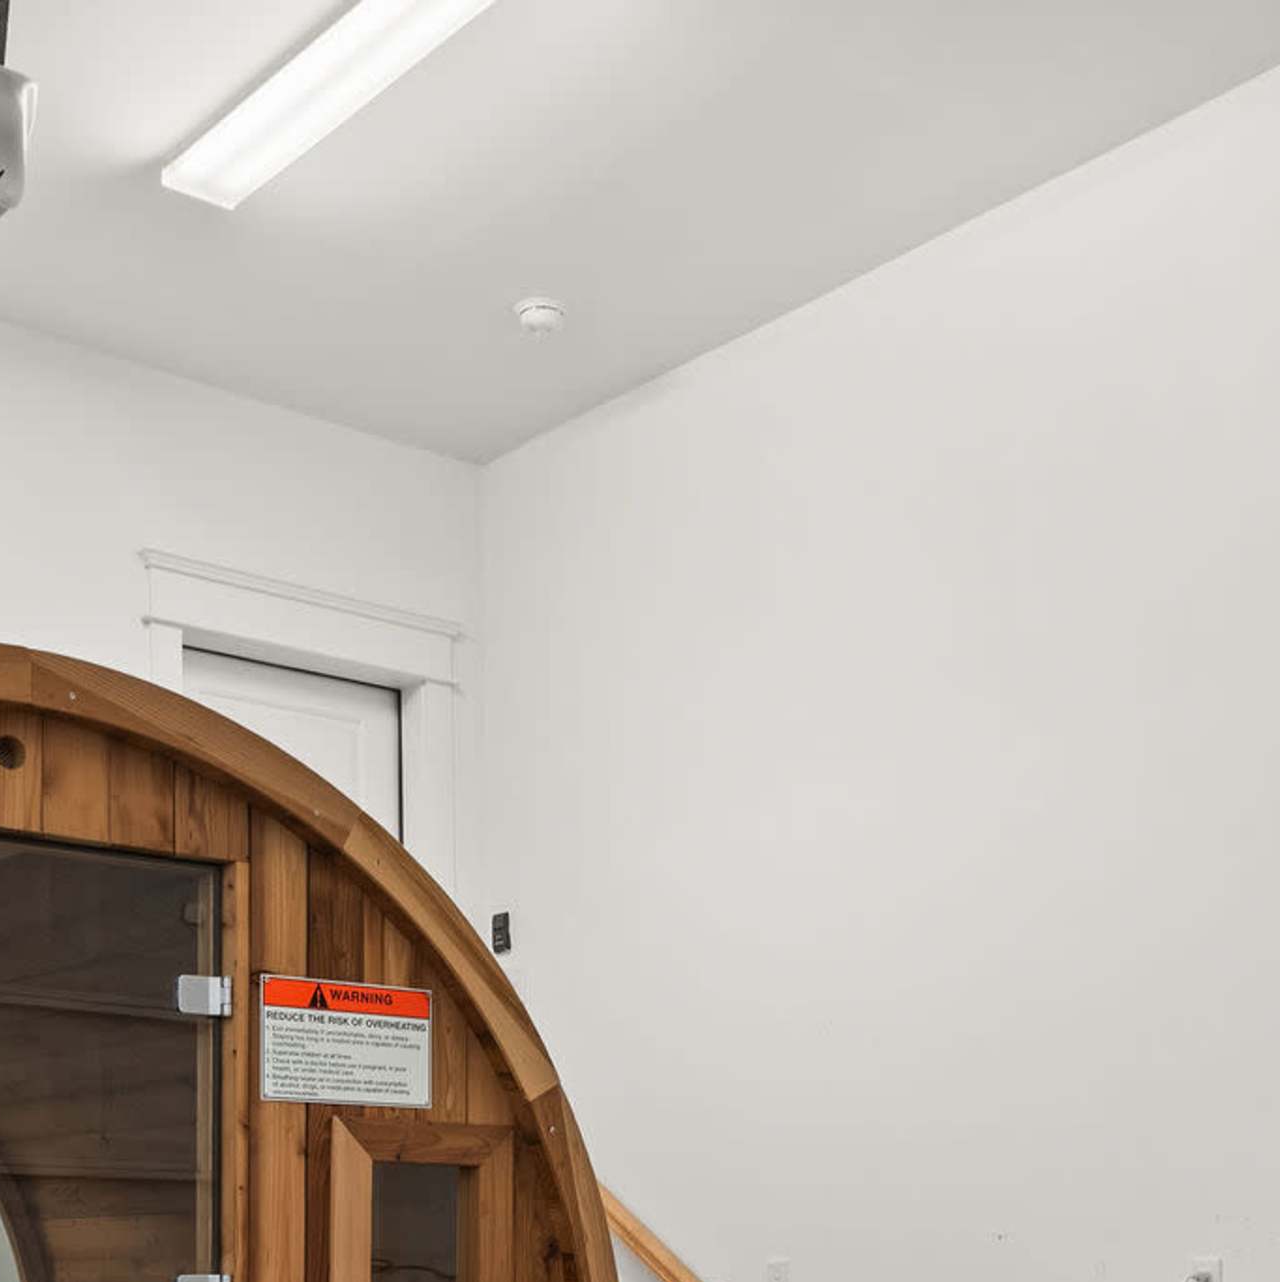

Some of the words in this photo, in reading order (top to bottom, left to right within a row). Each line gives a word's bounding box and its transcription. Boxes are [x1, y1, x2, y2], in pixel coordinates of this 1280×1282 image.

[330, 989, 394, 1006] WARNING
[266, 1011, 304, 1023] REDUCE
[308, 1015, 325, 1025] THE
[328, 1016, 349, 1027] RISK
[351, 1018, 363, 1028] OF
[366, 1019, 427, 1032] OVERHEATING
